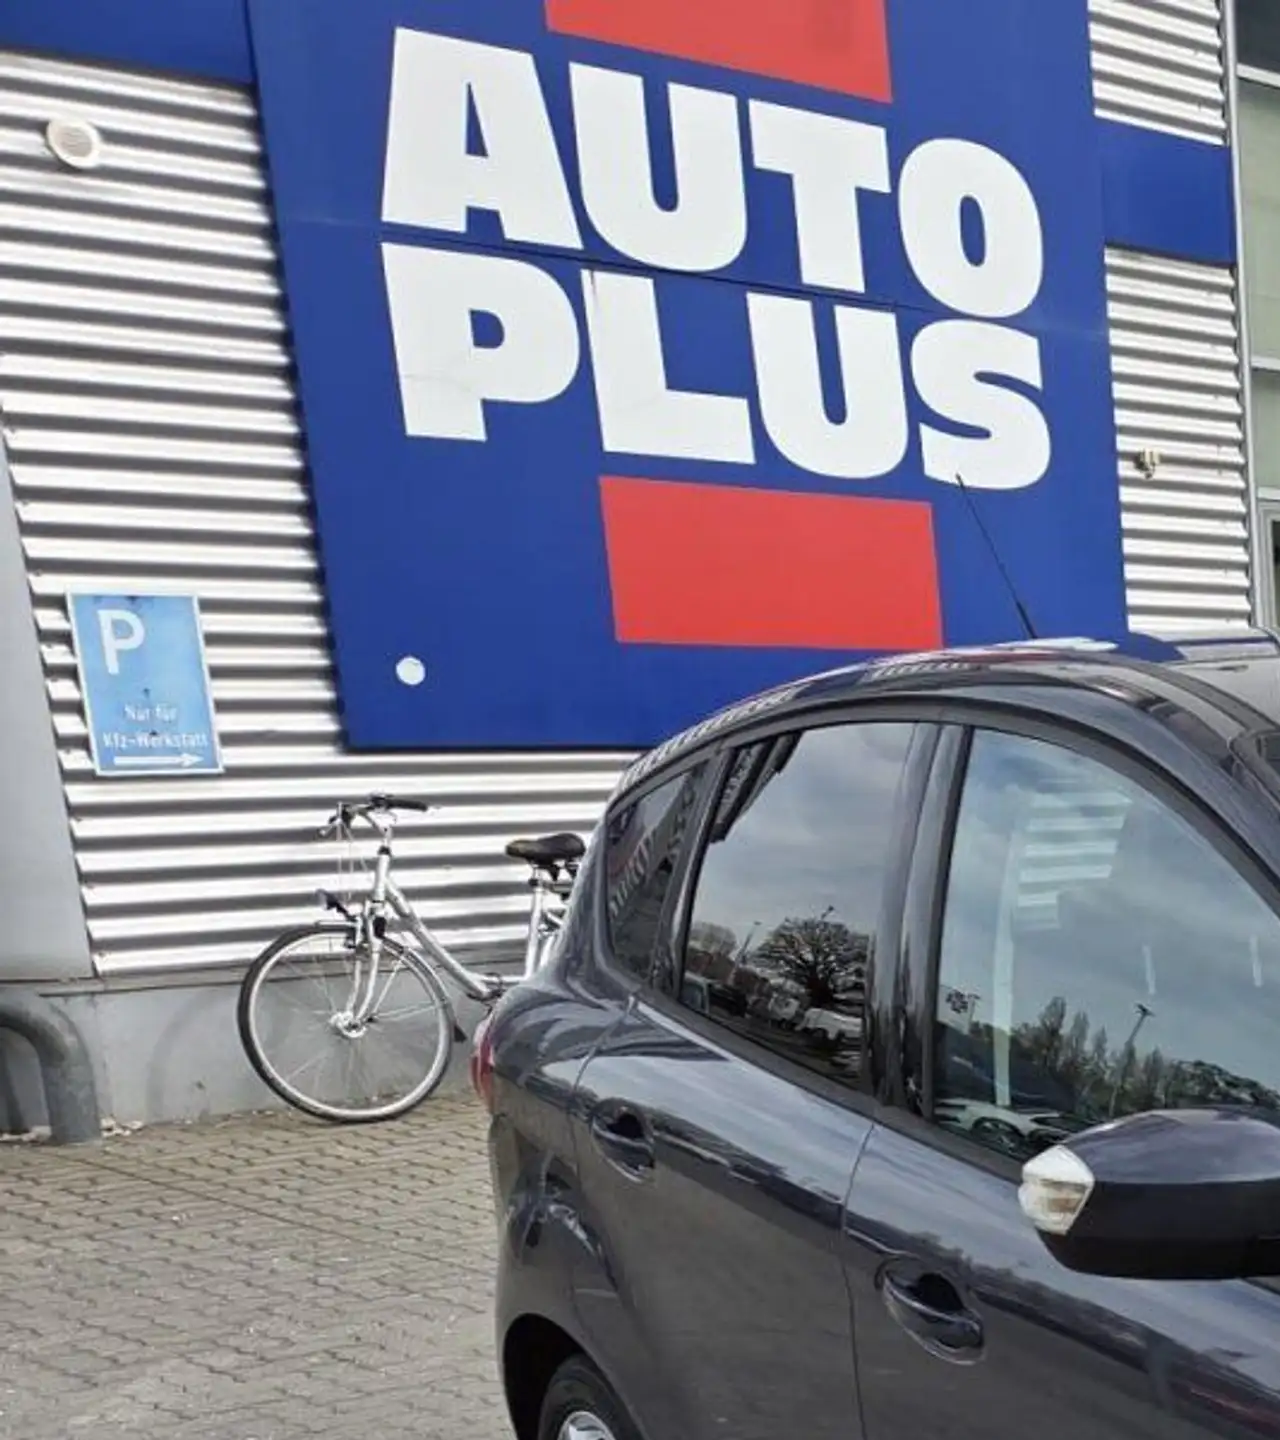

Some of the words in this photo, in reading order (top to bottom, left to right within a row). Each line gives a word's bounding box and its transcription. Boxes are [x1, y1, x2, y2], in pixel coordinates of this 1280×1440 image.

[382, 26, 1043, 318] AUTO
[381, 241, 1050, 489] PLUS
[97, 609, 146, 675] P
